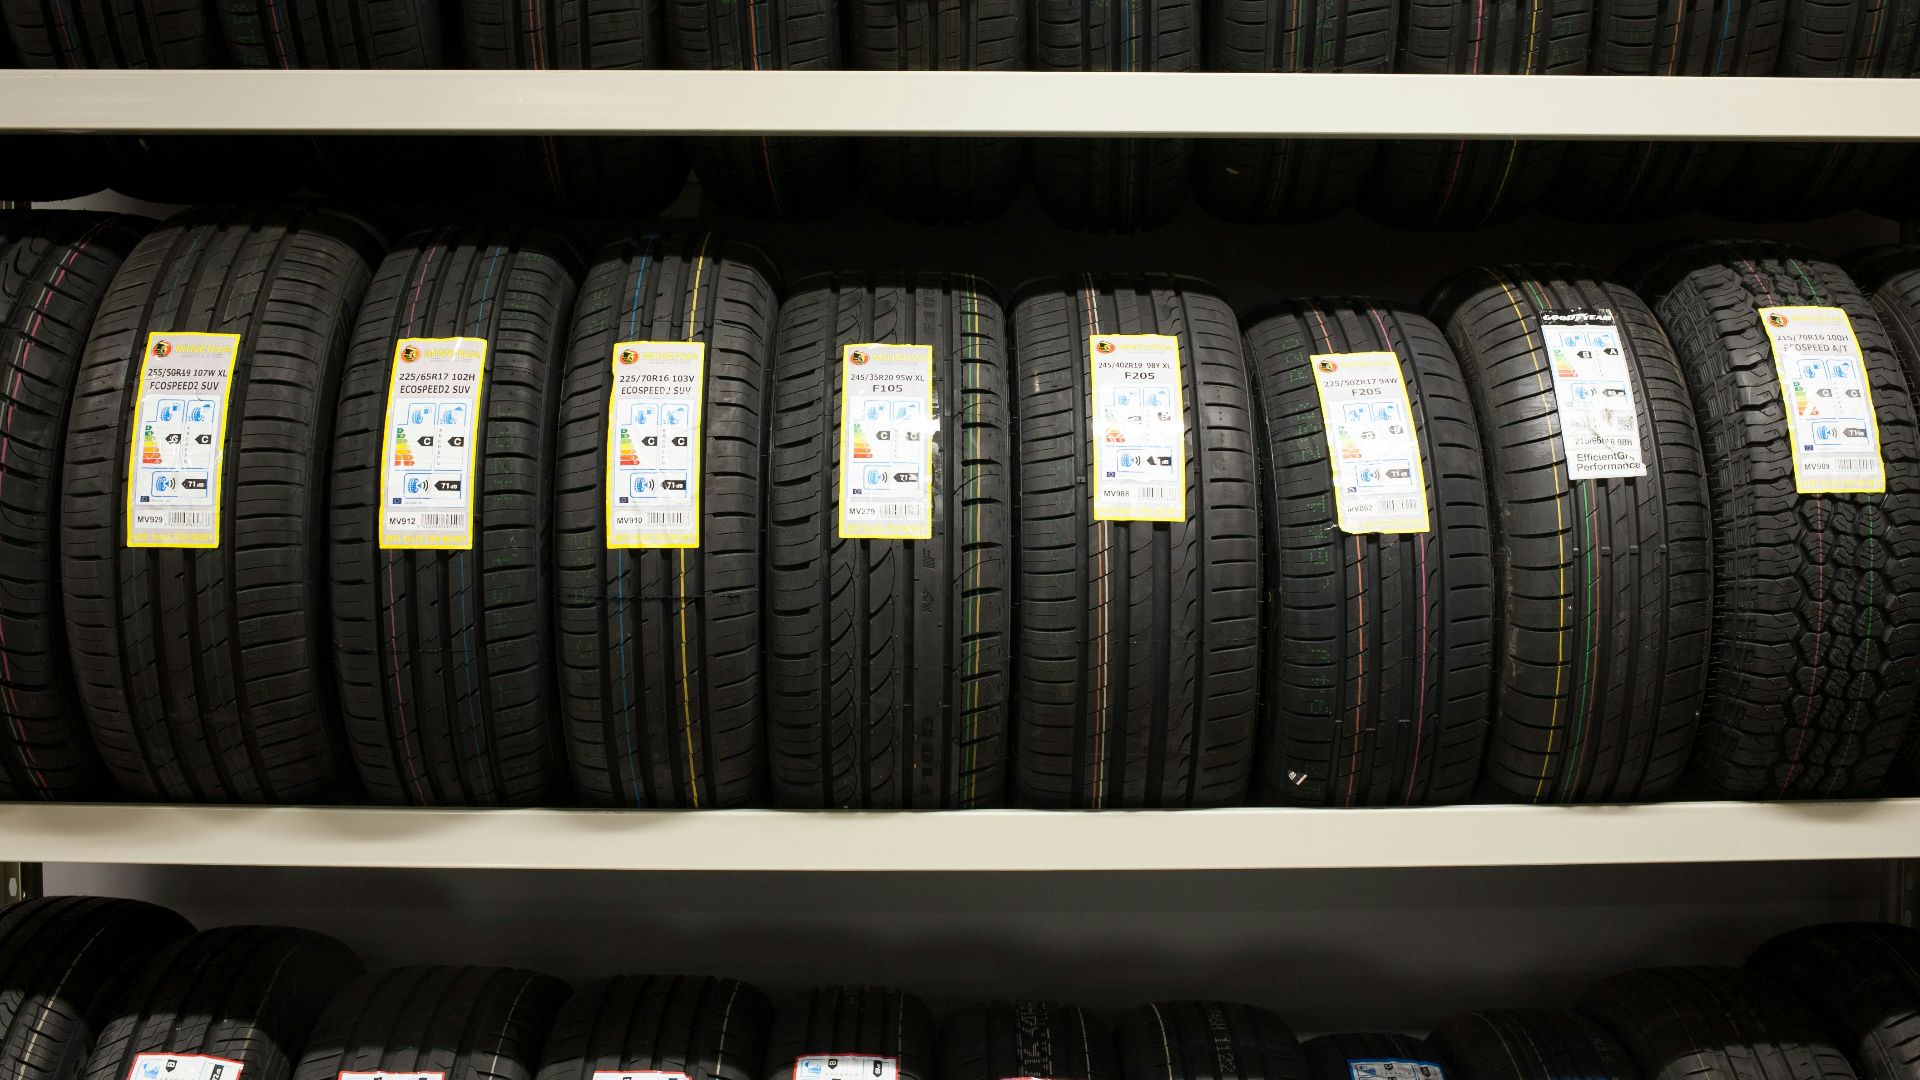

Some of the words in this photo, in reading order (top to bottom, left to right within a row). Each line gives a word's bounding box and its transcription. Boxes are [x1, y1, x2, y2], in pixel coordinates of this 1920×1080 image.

[1832, 345, 1847, 353] A/T
[148, 369, 190, 377] 255/50R19
[400, 373, 448, 381] 225/65R17
[452, 373, 475, 381] 102H
[201, 382, 219, 390] SUV
[1324, 379, 1376, 387] 225/50ZR17
[400, 385, 449, 393] ECOSPEED2
[452, 385, 470, 393] SUV
[1352, 388, 1381, 396] F205
[1576, 462, 1640, 471] Performance
